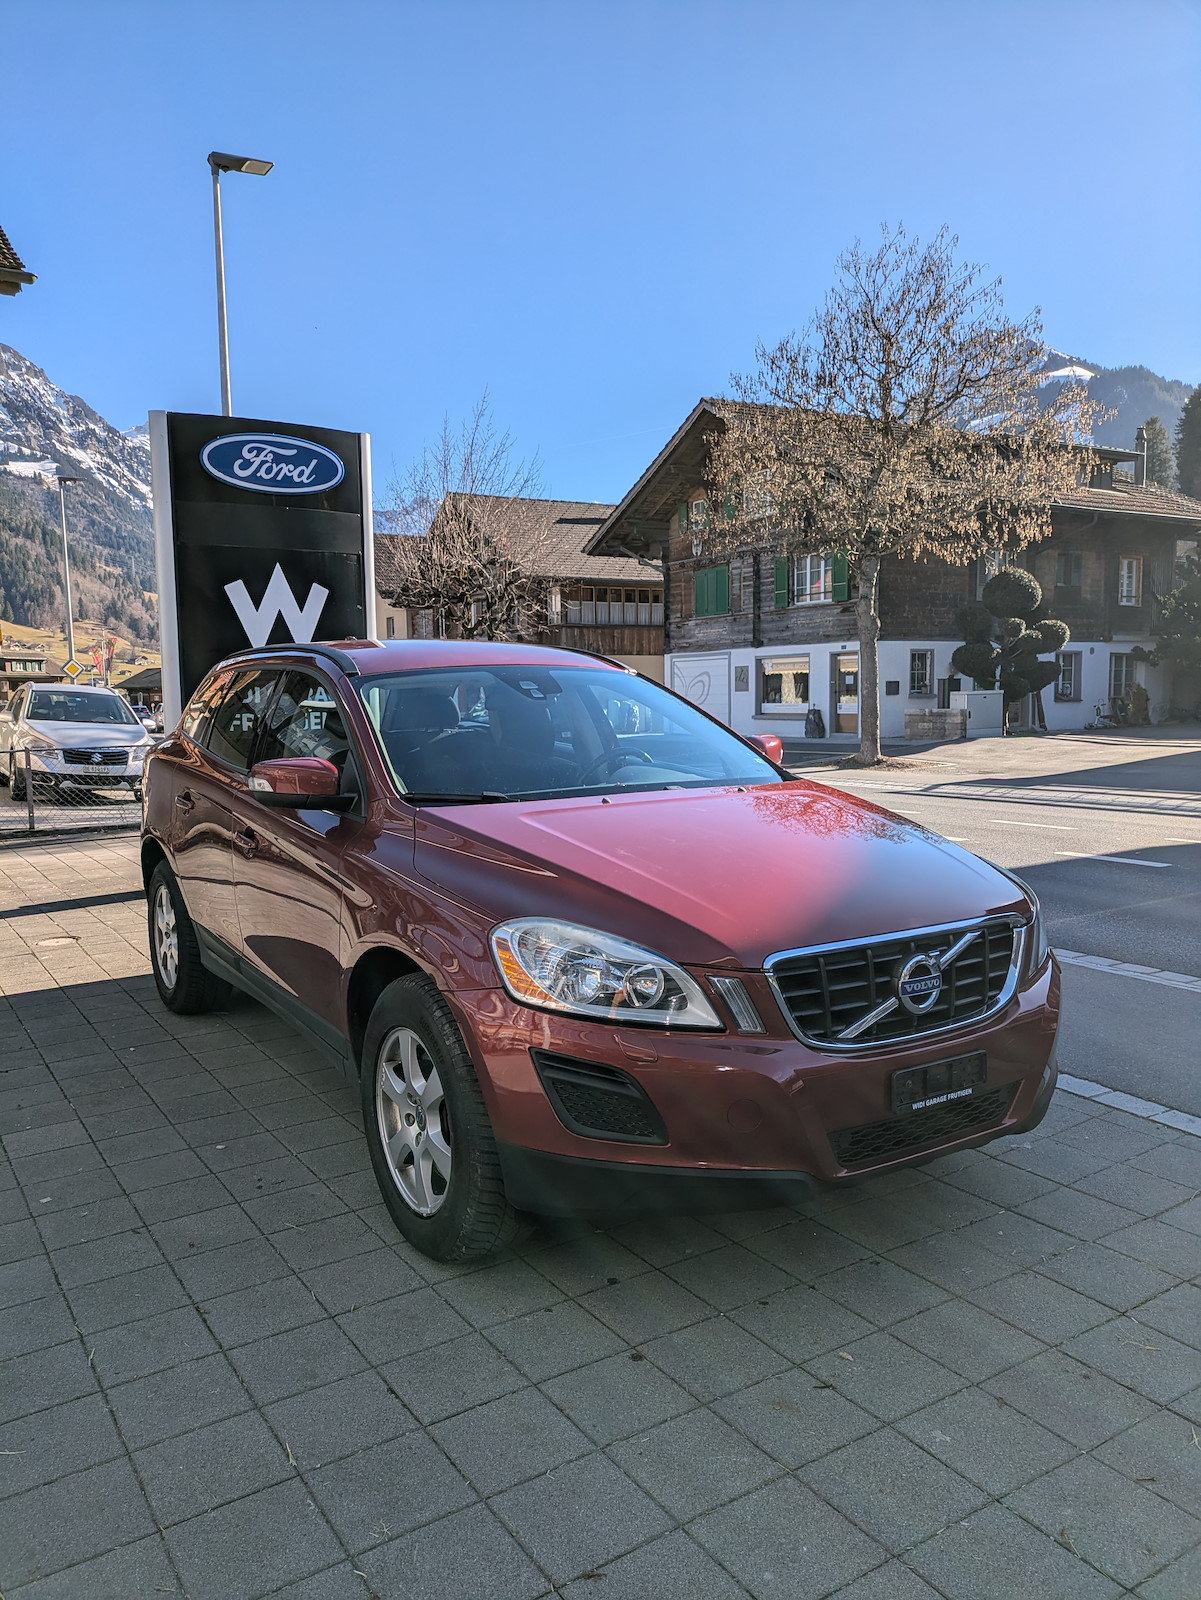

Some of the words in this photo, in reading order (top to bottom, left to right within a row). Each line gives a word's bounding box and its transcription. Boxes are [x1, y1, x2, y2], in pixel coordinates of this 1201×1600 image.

[233, 442, 318, 484] Ford
[223, 562, 330, 648] W
[904, 979, 939, 992] VOLVO
[912, 1101, 925, 1110] WIDI
[925, 1095, 947, 1106] GARAGE
[948, 1088, 972, 1100] FRUTIGEN
